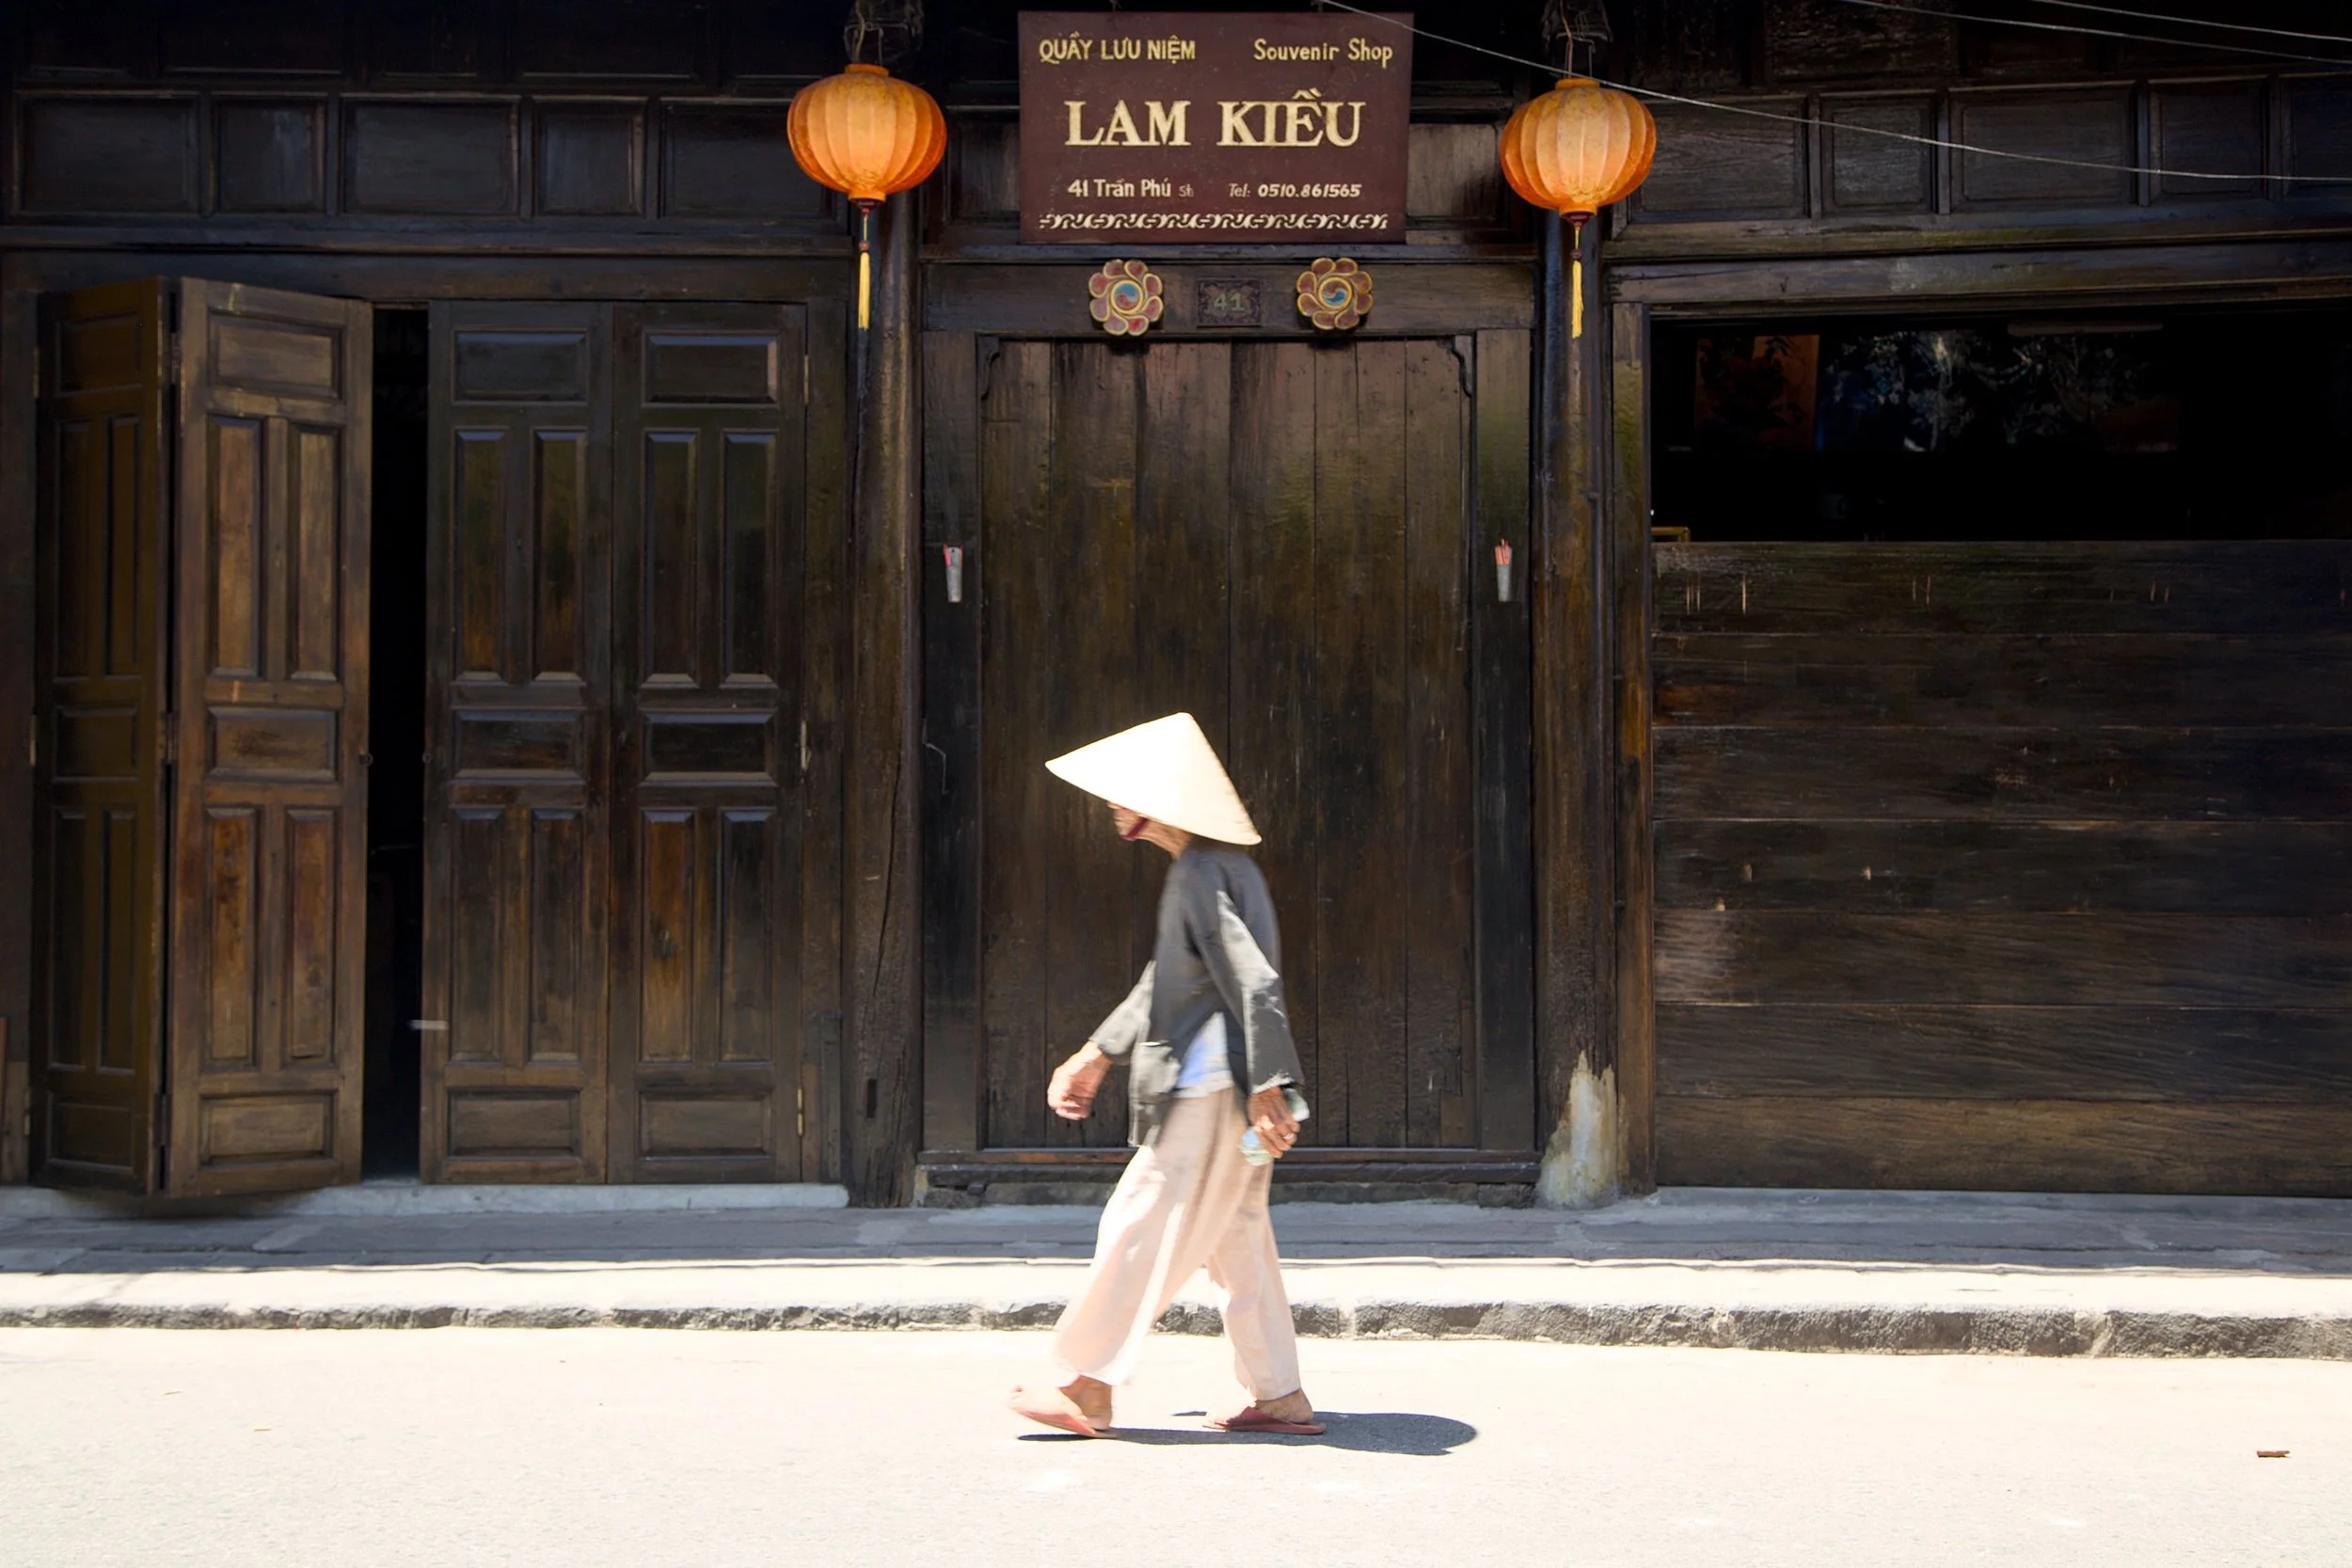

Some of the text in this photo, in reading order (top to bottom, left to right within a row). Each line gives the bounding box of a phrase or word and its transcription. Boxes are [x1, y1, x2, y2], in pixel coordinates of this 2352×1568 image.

[1147, 35, 1196, 64] NIỆM
[1253, 38, 1393, 69] Souvenir Shop
[1064, 87, 1366, 147] LAM KIỀU
[1067, 179, 1089, 198] 41
[1140, 177, 1171, 198] Phú
[1229, 182, 1362, 198] Tel: 0510.861565
[1214, 293, 1246, 311] 41
